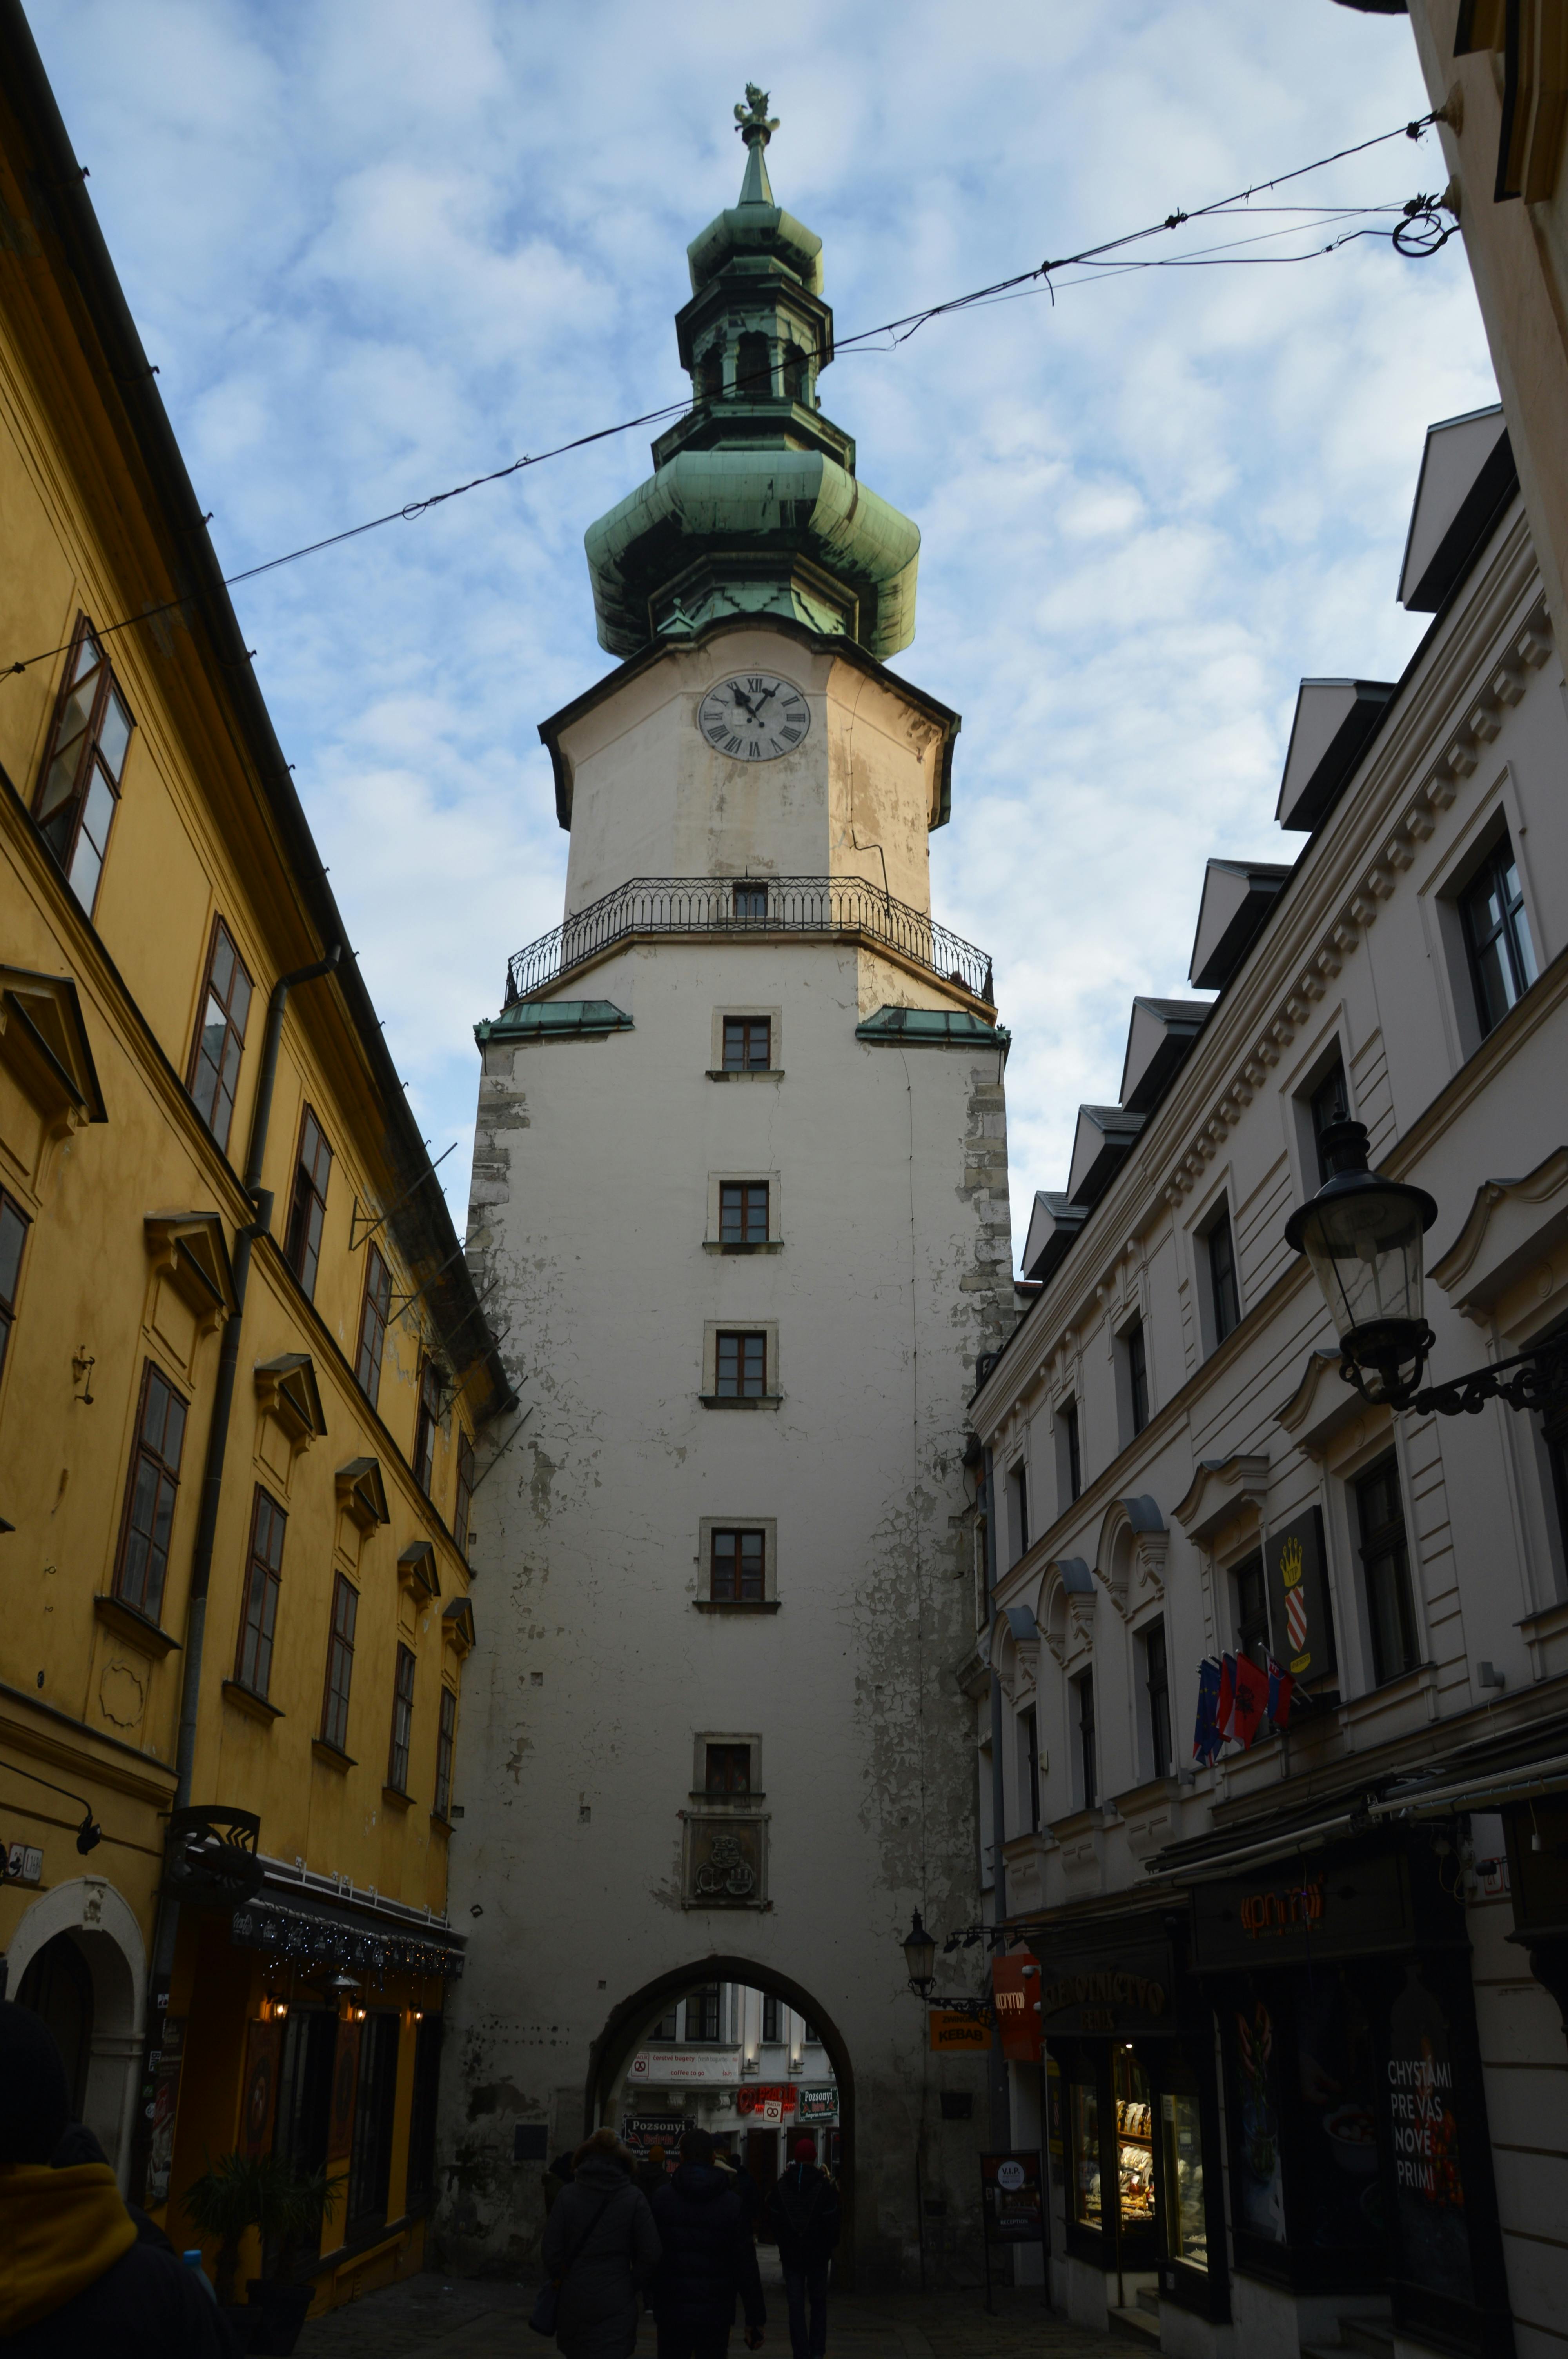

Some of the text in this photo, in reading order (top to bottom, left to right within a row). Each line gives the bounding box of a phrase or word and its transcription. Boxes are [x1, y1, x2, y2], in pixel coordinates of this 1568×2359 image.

[747, 678, 763, 692] XII
[1287, 1565, 1298, 1582] VIP
[939, 2028, 983, 2043] KEBAB
[805, 2089, 833, 2104] Pozsonyi
[1390, 2089, 1443, 2122] PRE VÁS
[633, 2120, 686, 2135] Pozsonyi
[1394, 2123, 1431, 2155] NOVÉ
[1397, 2159, 1435, 2191] PRIMI
